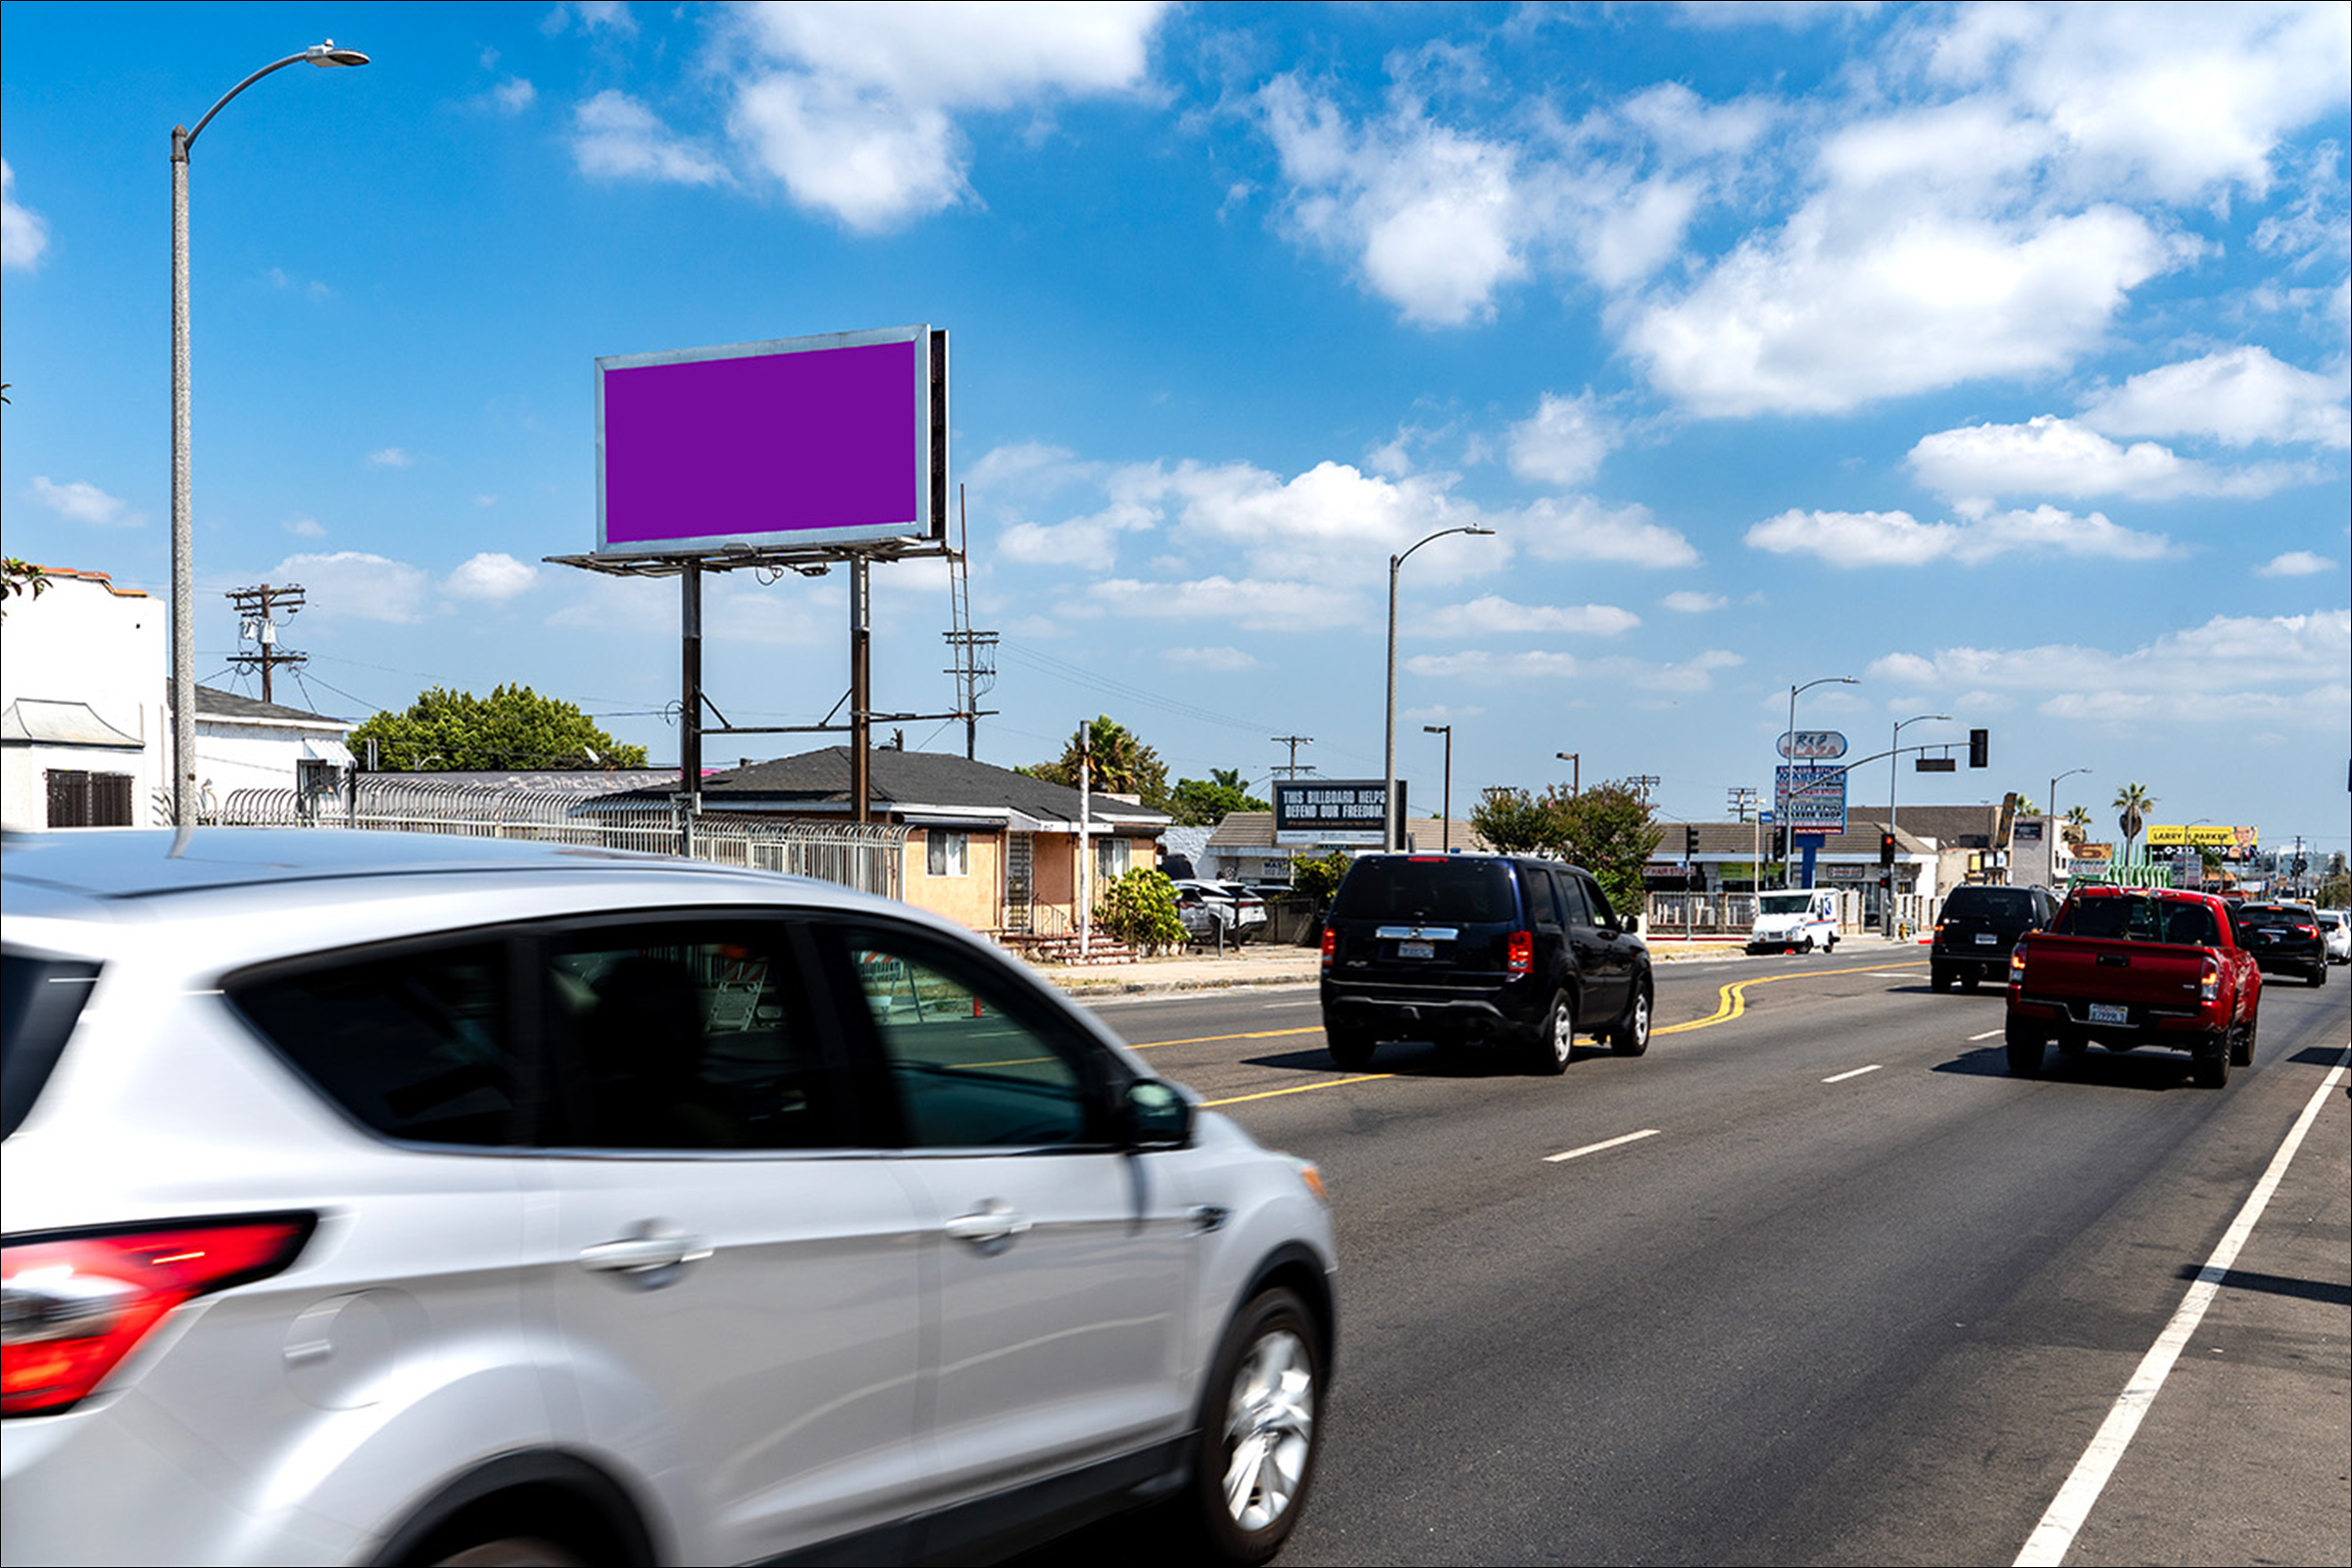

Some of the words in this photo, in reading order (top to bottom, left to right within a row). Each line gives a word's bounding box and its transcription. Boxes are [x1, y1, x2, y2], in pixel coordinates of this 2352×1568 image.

[1283, 790, 1304, 804] THIS
[1306, 790, 1355, 804] BILLBOARD
[1358, 790, 1387, 804] HELPS
[1285, 805, 1317, 818] DEFEND
[1320, 805, 1339, 818] OUR
[1343, 805, 1385, 818] FREEDOM.
[1651, 867, 1668, 876] HAIR
[1670, 867, 1696, 876] STUDO
[2068, 865, 2083, 875] CAR
[2085, 865, 2108, 874] WASH
